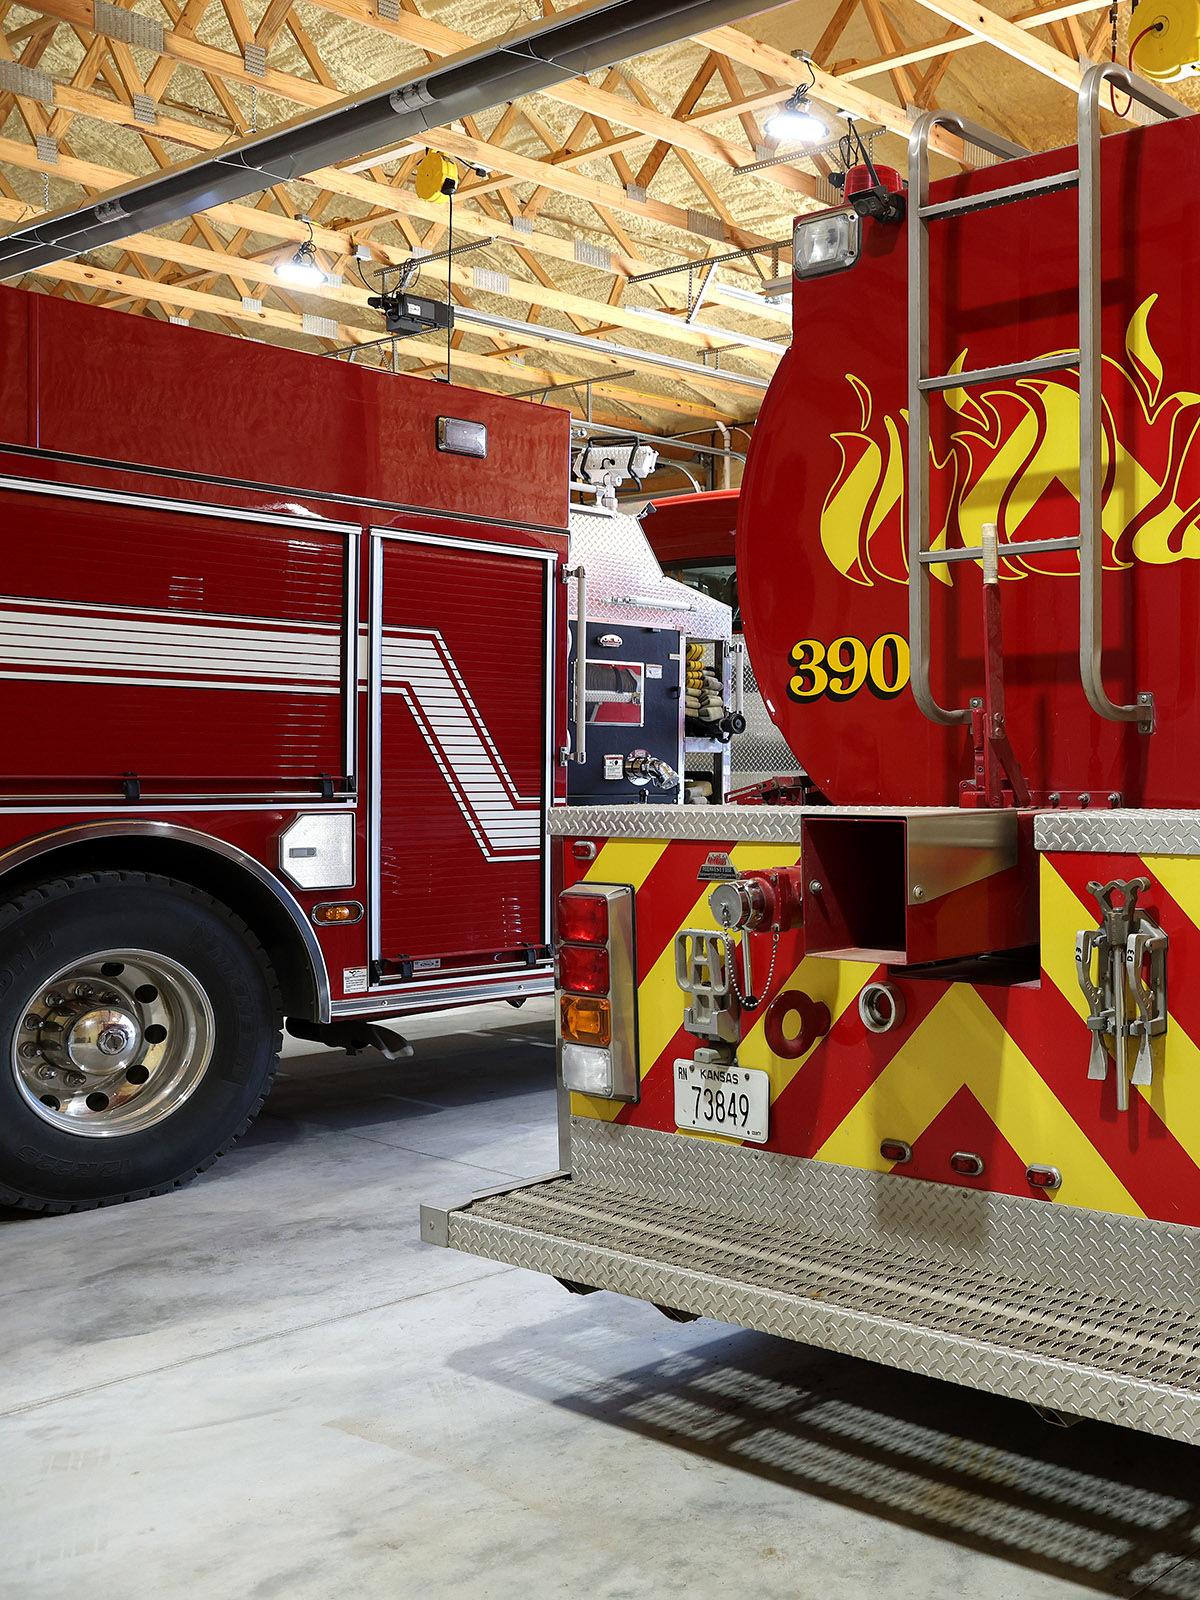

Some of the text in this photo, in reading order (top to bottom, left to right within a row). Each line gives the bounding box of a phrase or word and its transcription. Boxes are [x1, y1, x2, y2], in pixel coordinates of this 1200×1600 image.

[786, 632, 910, 704] 390
[678, 1066, 739, 1085] RN KANSAS
[691, 1085, 750, 1127] 73849
